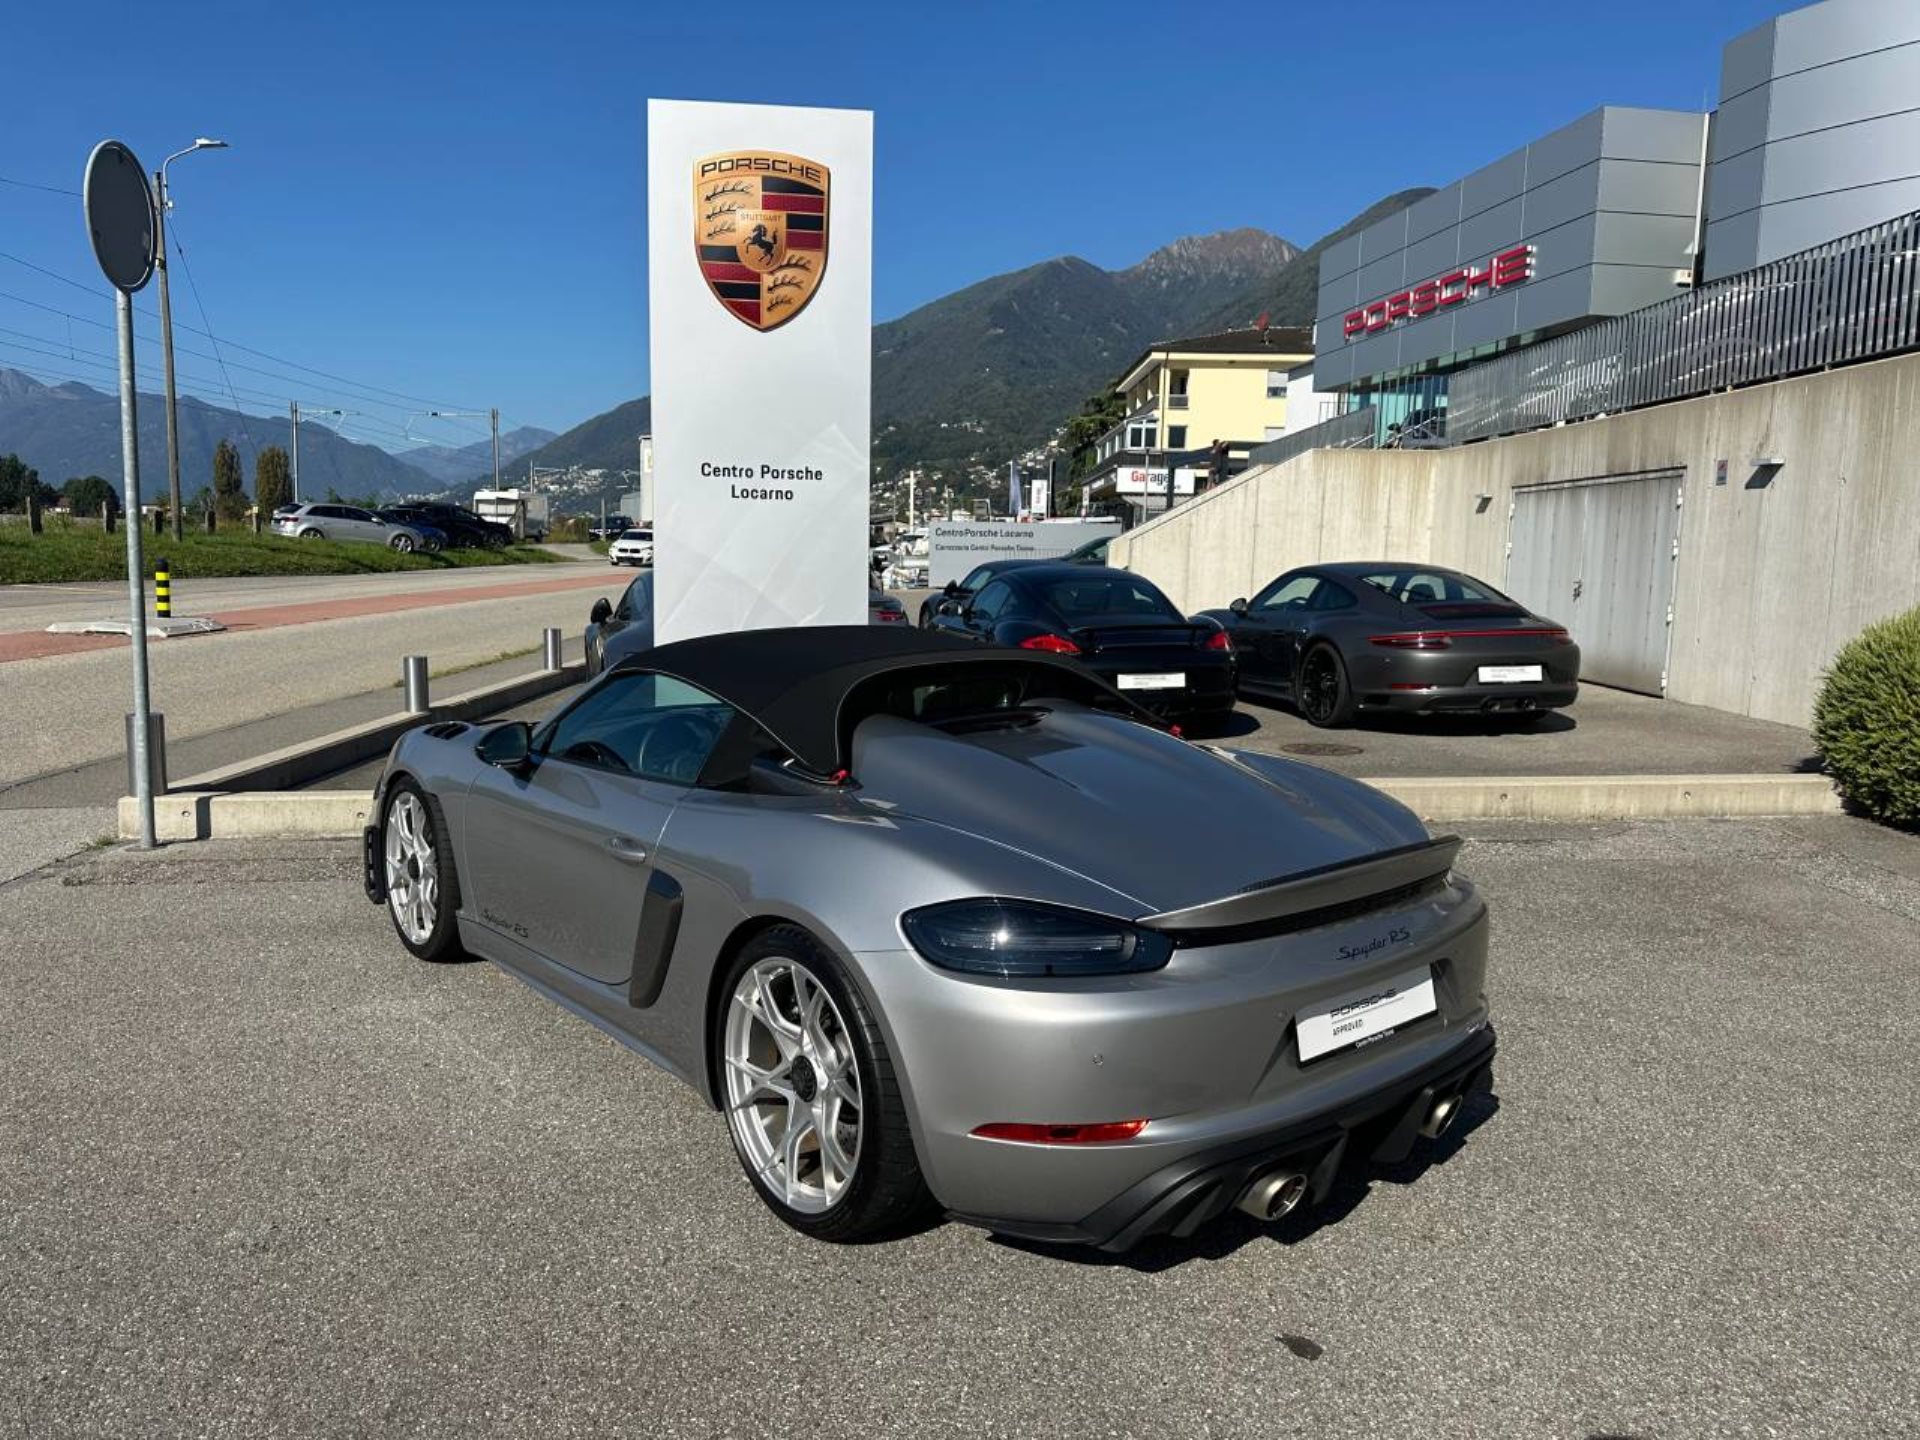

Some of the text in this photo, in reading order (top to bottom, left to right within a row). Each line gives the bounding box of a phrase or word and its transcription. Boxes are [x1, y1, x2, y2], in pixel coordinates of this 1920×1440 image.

[701, 158, 821, 183] PORSCHE
[1344, 245, 1537, 342] PORSCHE
[701, 462, 823, 480] Centro Porsche
[731, 484, 794, 500] Locarno
[935, 527, 1034, 538] Centro Porsche Locarno
[1335, 926, 1410, 960] Spyder RS
[1330, 988, 1396, 1018] PORSCHE
[1333, 1019, 1364, 1036] APPROVED
